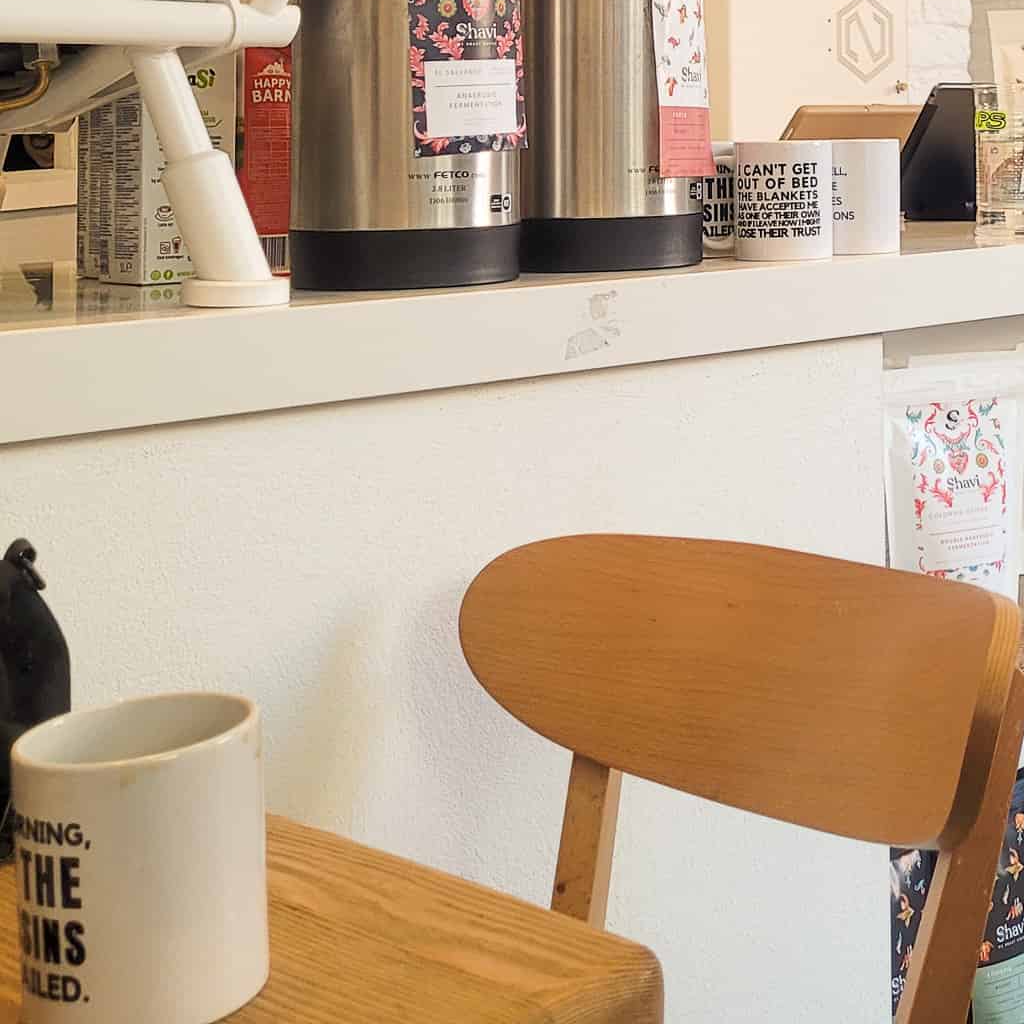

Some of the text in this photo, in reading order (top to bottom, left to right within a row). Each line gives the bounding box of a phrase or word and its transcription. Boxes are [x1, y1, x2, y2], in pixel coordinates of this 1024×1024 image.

[456, 22, 497, 39] Shavi
[187, 68, 216, 88] aSì
[254, 78, 291, 89] HAPPY
[744, 164, 786, 176] CAN'T
[792, 163, 817, 175] GET
[738, 178, 759, 190] OUT
[765, 178, 785, 189] OF
[792, 177, 818, 189] BED
[738, 190, 818, 202] THE BLANKETS
[738, 203, 758, 212] HAVE
[760, 202, 805, 211] ACCEPTED
[745, 212, 760, 220] ONE
[761, 212, 773, 220] OF
[774, 211, 799, 220] THEIR
[801, 210, 820, 219] OWN
[738, 227, 821, 238] LOSE THEIR TRUST
[947, 474, 980, 491] Shavi
[16, 814, 90, 850] RNING,
[21, 848, 82, 909] THE
